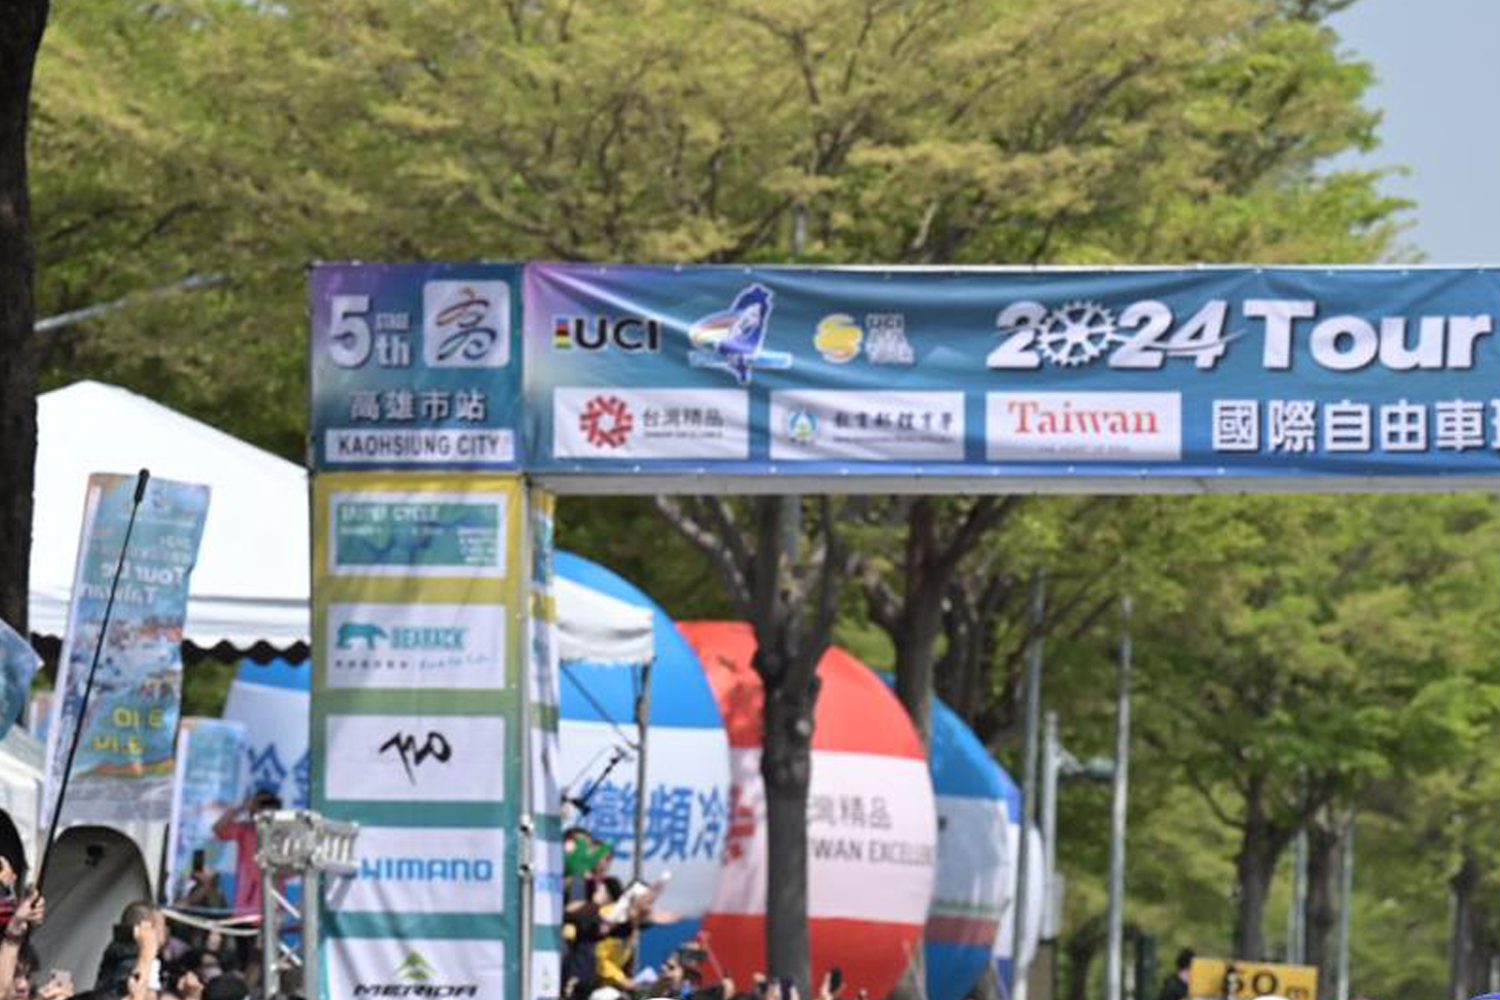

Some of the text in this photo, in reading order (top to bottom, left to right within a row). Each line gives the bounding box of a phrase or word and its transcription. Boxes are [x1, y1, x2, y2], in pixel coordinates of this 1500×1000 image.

[330, 295, 372, 368] 5
[574, 316, 662, 352] UCI
[1243, 299, 1492, 371] Tour
[377, 335, 410, 366] th
[350, 388, 487, 422] 高雄市站
[1007, 400, 1160, 434] Taiwan
[338, 435, 501, 457] KAOHSIUNG CITY
[355, 858, 494, 882] HIMANO
[352, 983, 479, 998] MERIDA
